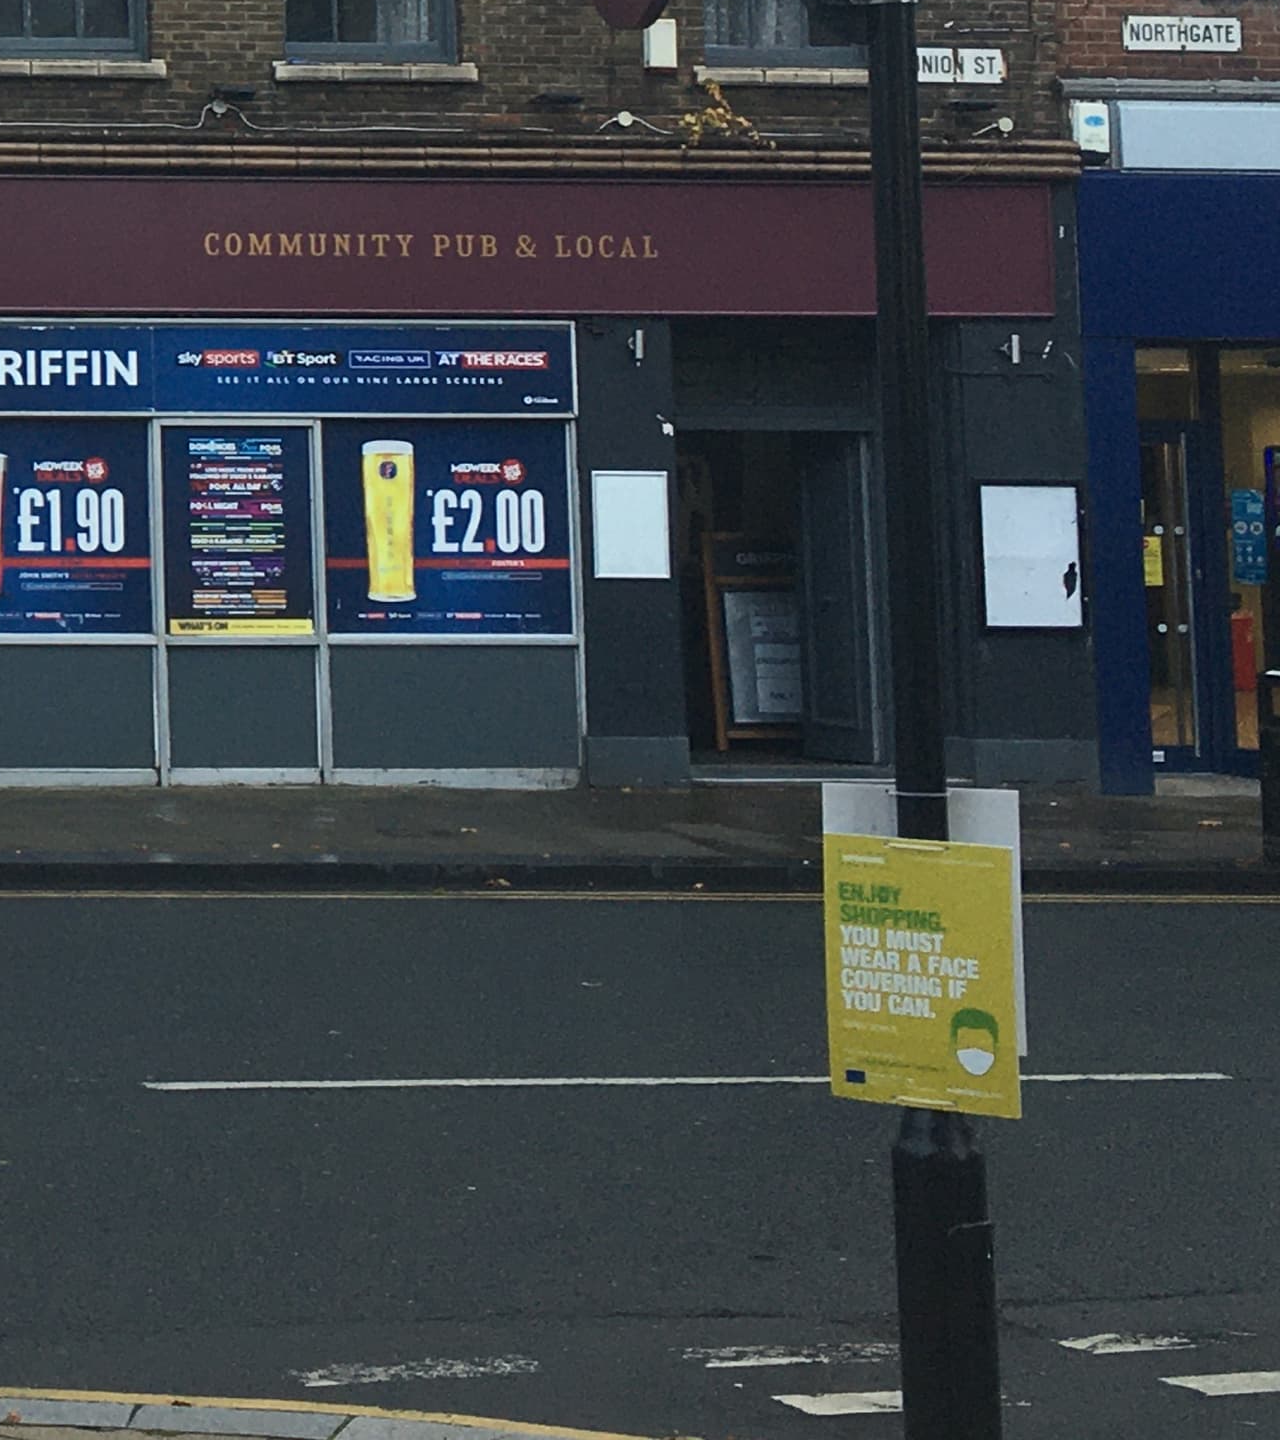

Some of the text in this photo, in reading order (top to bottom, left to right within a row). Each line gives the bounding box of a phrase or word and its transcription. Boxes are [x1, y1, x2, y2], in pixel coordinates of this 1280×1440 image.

[1129, 23, 1236, 44] NORTHGATE
[974, 56, 1003, 75] ST.
[204, 232, 658, 259] COMMUNITY PUB & LOCAL
[177, 352, 256, 367] sky sports
[297, 352, 337, 367] Sport
[438, 353, 459, 366] AT
[267, 376, 290, 384] ALL
[297, 376, 315, 384] ON
[17, 488, 125, 552] £1.90
[432, 489, 545, 553] £2.00
[838, 881, 902, 905] ENJOY
[840, 925, 944, 954] YOU MUST
[840, 947, 980, 980] WEAR A FACE
[841, 968, 967, 999] COVERING IF
[842, 989, 936, 1019] YOU CAN.
